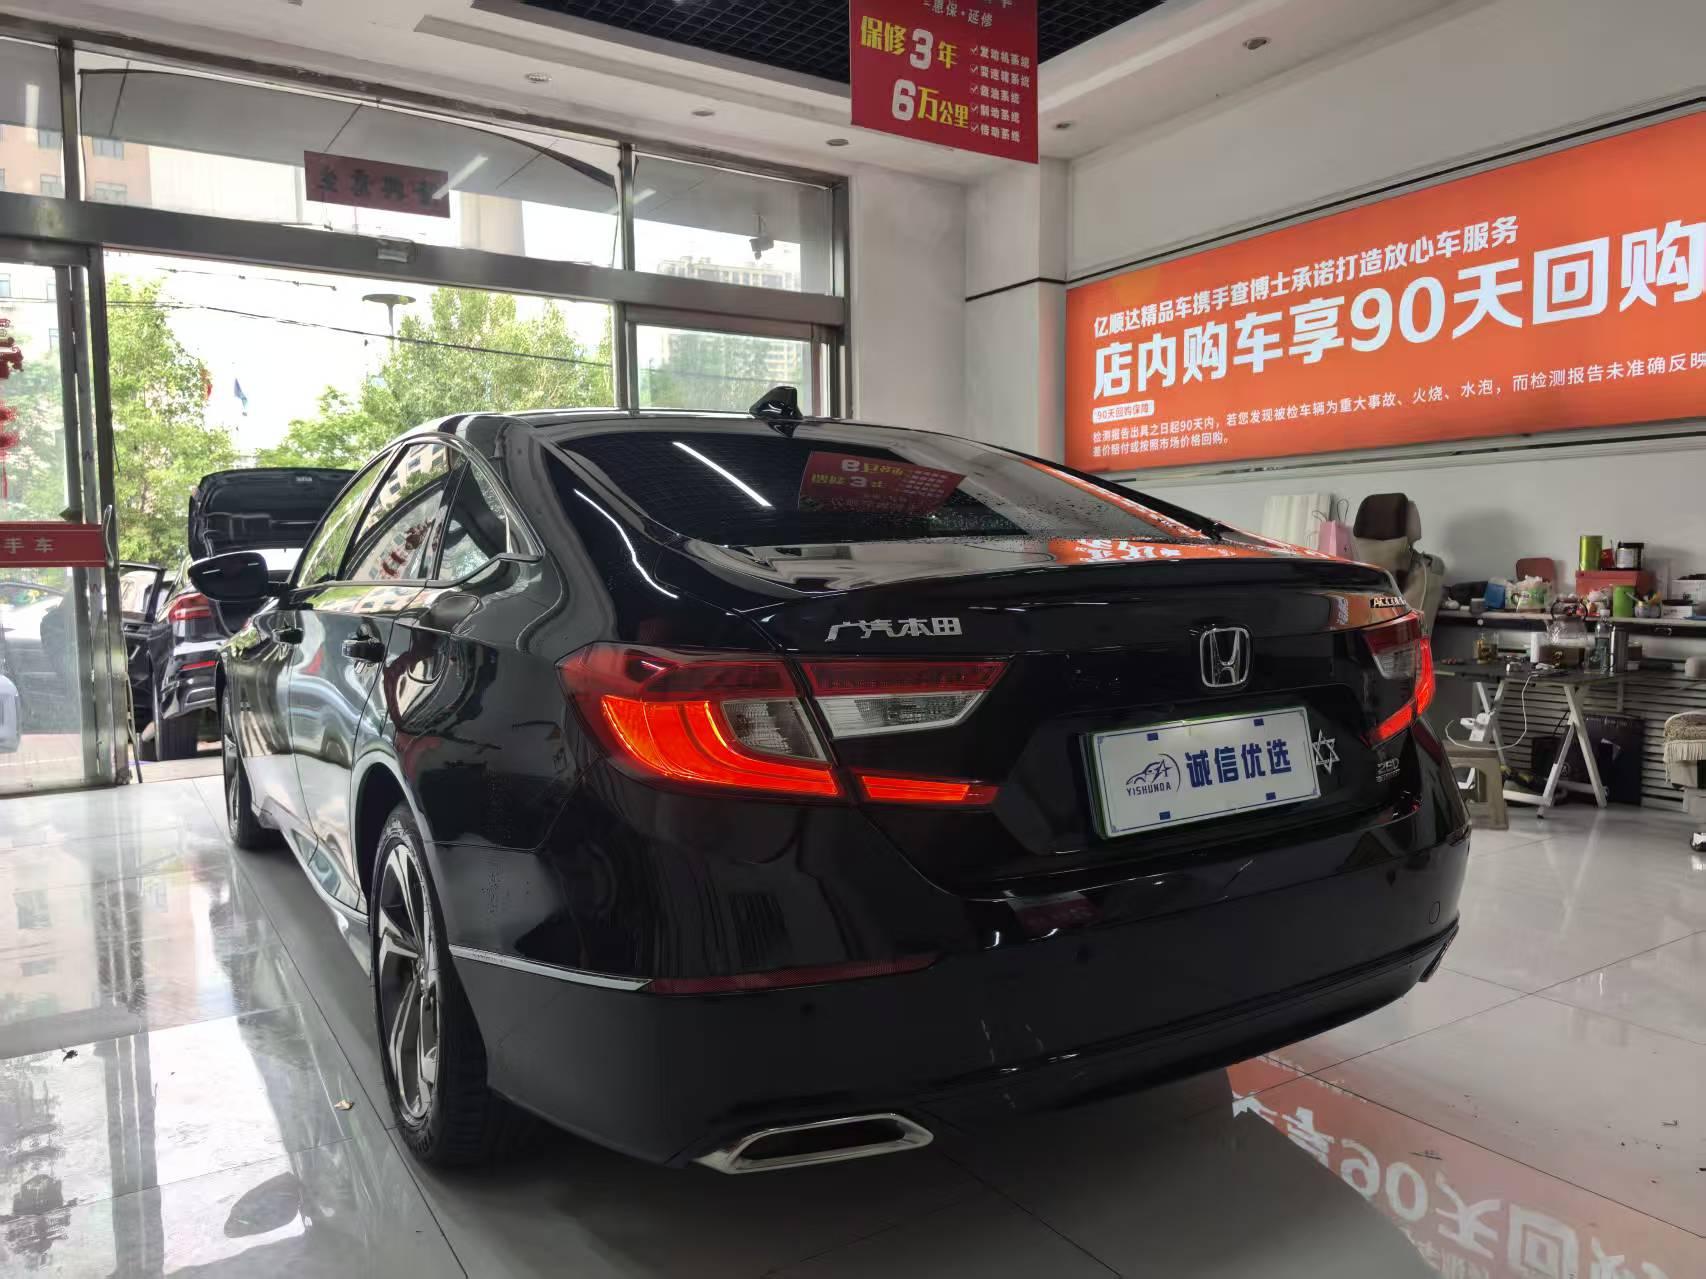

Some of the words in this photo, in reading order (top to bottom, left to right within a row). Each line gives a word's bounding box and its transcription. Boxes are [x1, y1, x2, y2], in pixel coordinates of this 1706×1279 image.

[860, 15, 959, 70] 保修3年
[891, 79, 969, 129] 6万公里
[1094, 215, 1518, 338] 亿顺达精品车携手查博士承诺打造放心车服务
[1093, 219, 1706, 400] 店内购车享90天回购
[825, 616, 963, 642] 广汽本田
[1184, 738, 1292, 788] 诚信优选
[1126, 781, 1172, 797] YISHUNDA
